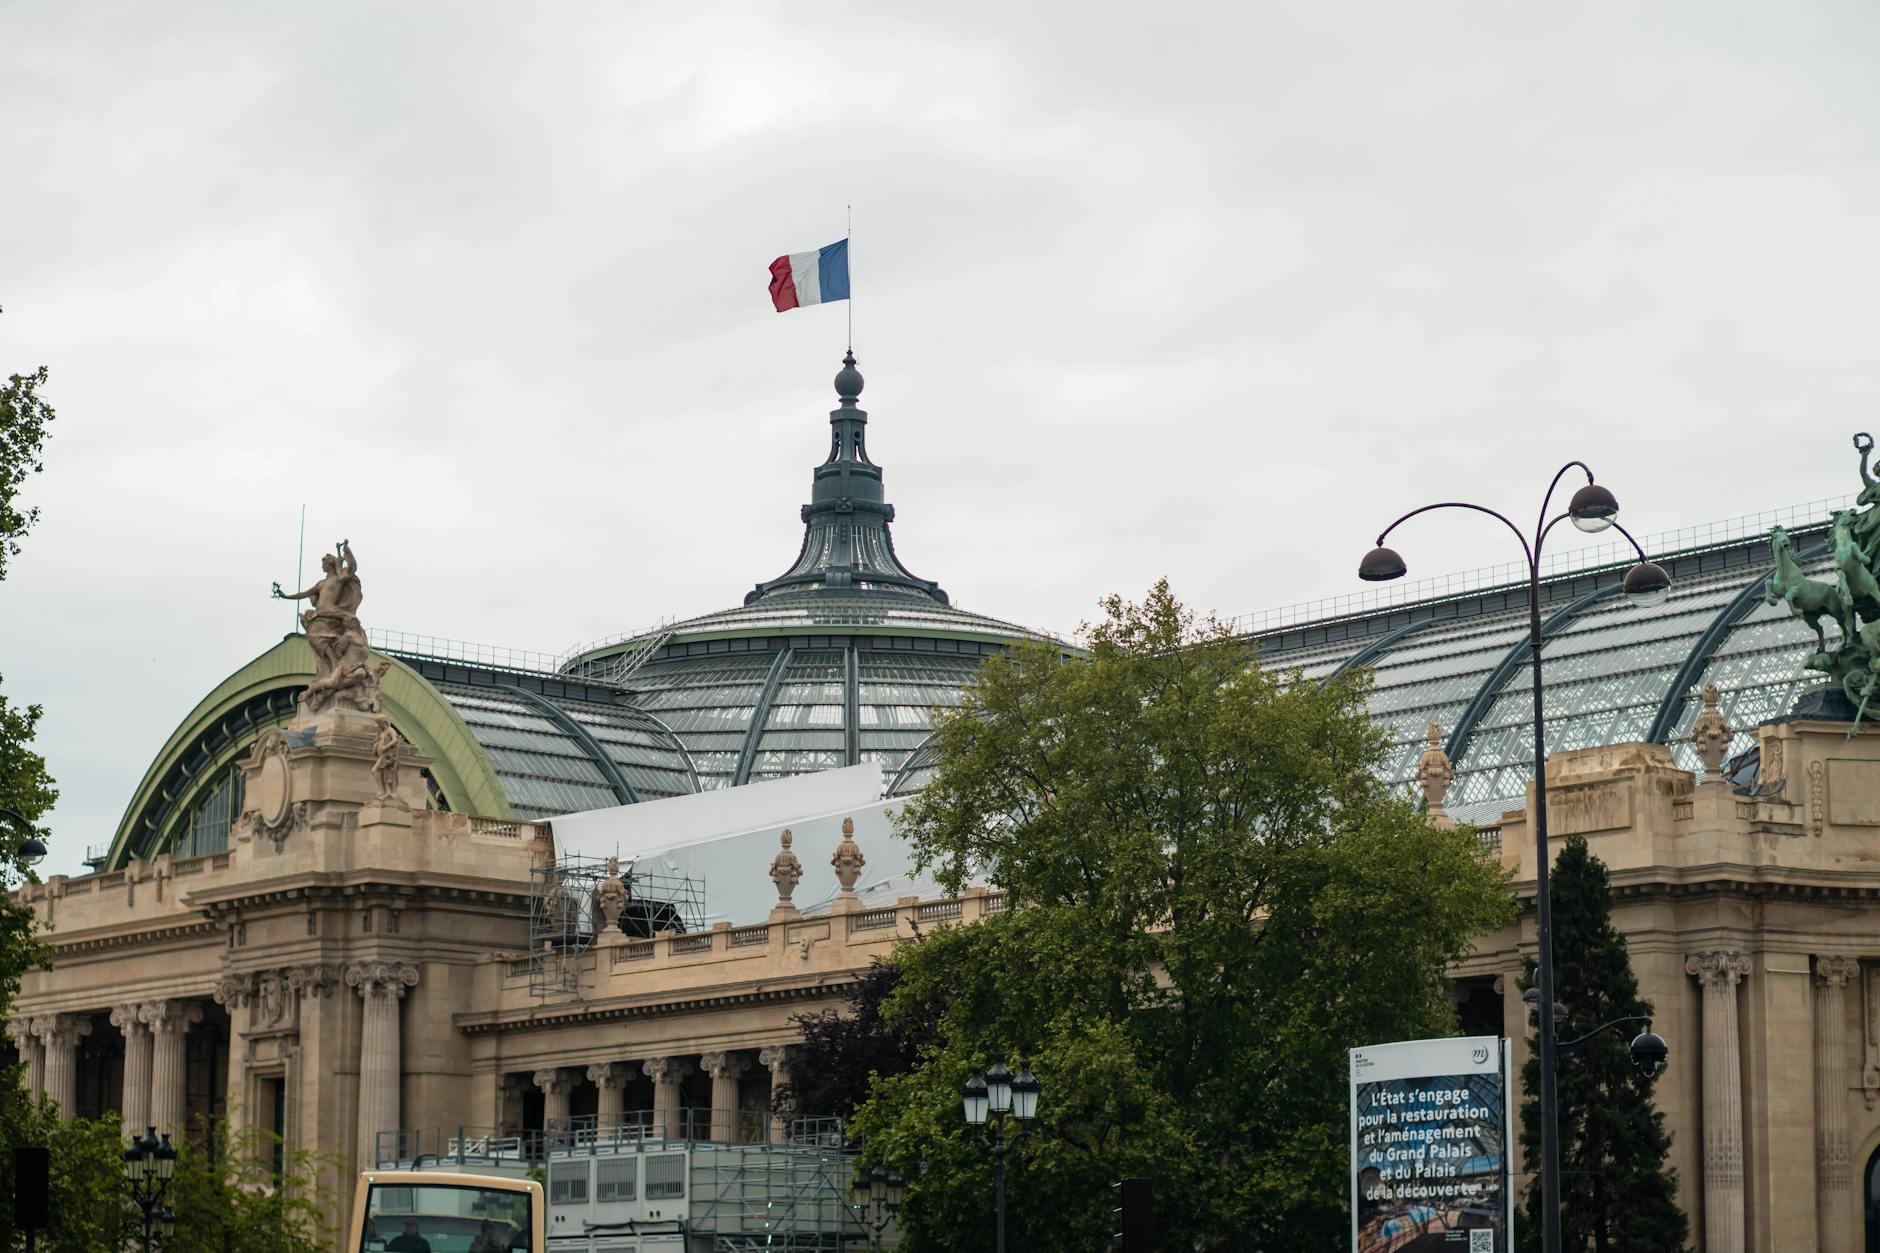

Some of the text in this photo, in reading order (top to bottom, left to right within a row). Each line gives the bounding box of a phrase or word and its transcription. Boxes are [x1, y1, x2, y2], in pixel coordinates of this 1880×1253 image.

[1371, 1088, 1470, 1107] L'État s'engage
[1358, 1104, 1489, 1131] pour la restauration
[1364, 1125, 1481, 1145] et l'aménagement
[1369, 1142, 1473, 1163] du Grand Palais
[1380, 1162, 1457, 1181] et du Palais
[1366, 1182, 1477, 1201] de la découverte
